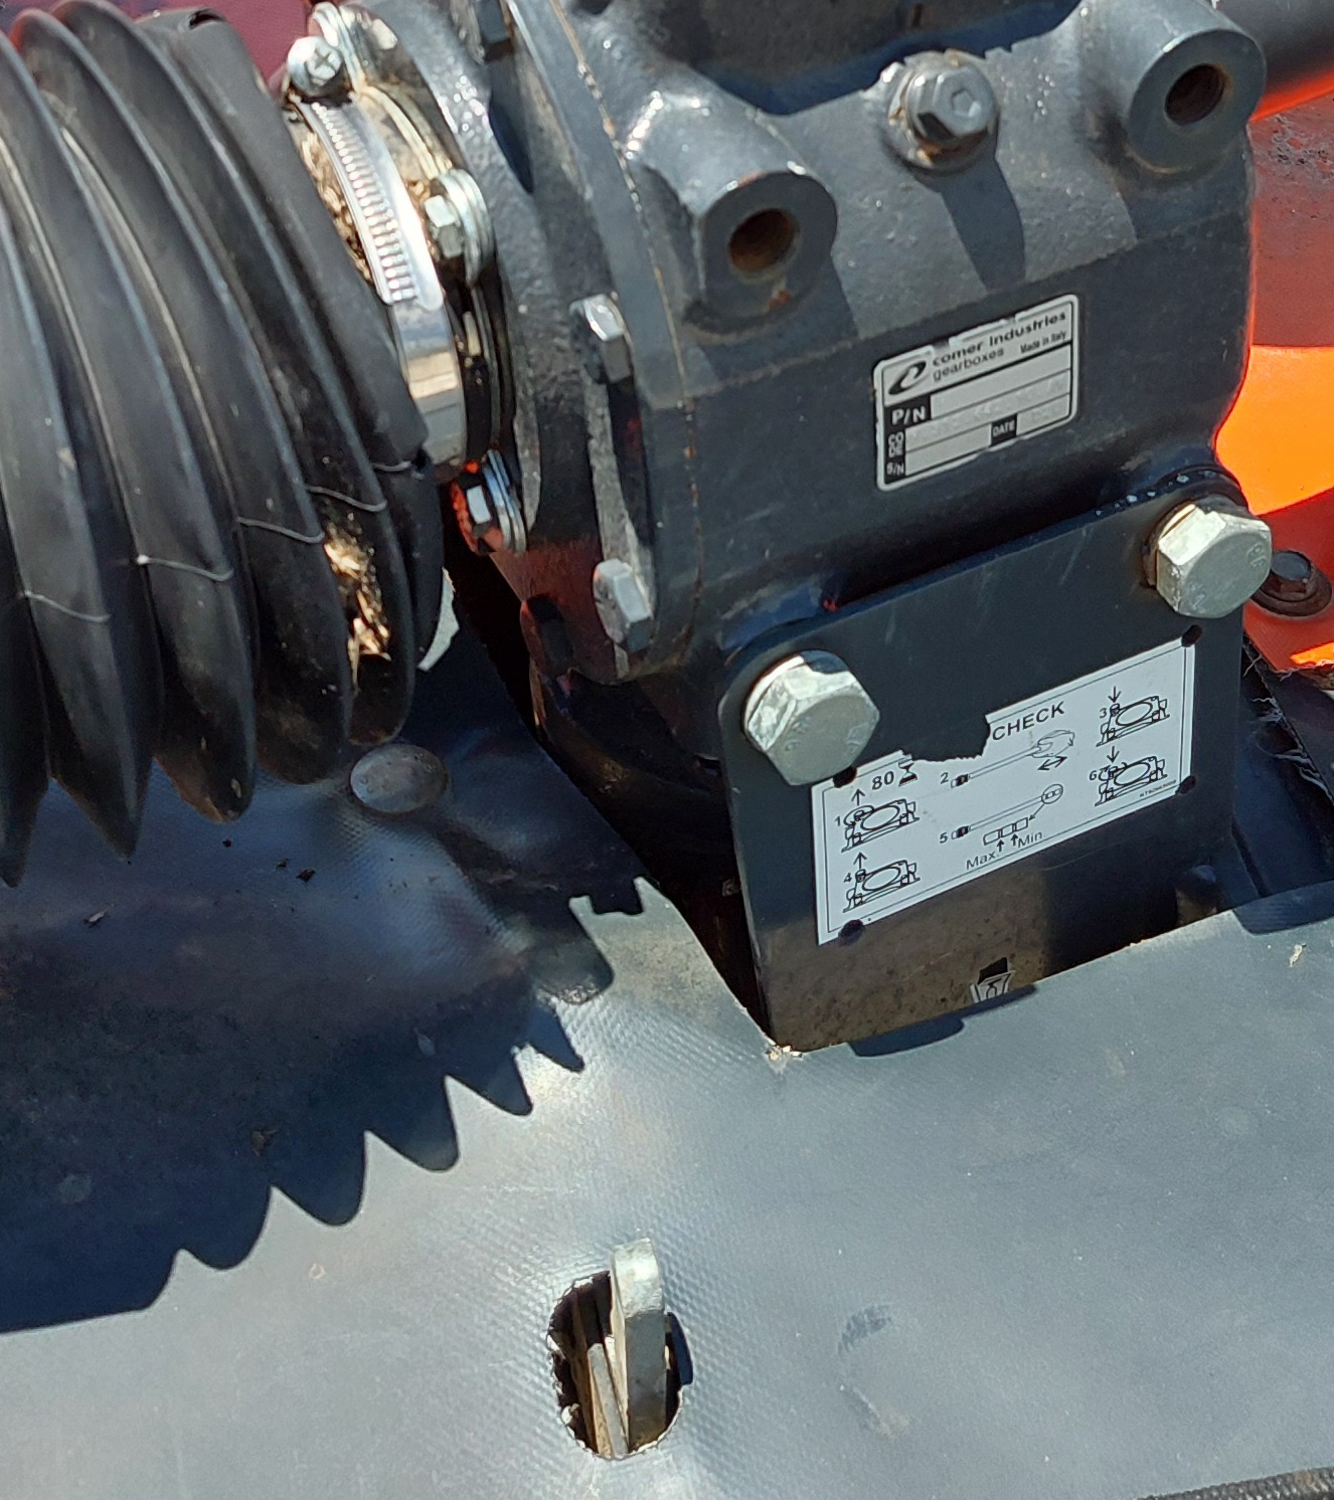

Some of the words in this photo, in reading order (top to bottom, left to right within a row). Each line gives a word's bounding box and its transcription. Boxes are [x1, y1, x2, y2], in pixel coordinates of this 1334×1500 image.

[1019, 340, 1040, 354] Made
[1051, 330, 1067, 342] Italy
[932, 340, 985, 367] comer
[932, 347, 1005, 382] gearboxes
[891, 405, 926, 426] P/N
[992, 419, 1015, 438] DATE
[886, 461, 905, 476] S/N
[992, 700, 1066, 741] CHECK
[1099, 707, 1107, 719] 3
[871, 770, 895, 790] 80
[940, 771, 949, 785] 2
[1089, 769, 1097, 781] 6
[834, 815, 841, 827] 1
[939, 831, 948, 844] 5
[1018, 830, 1043, 848] Min
[843, 872, 852, 883] 4
